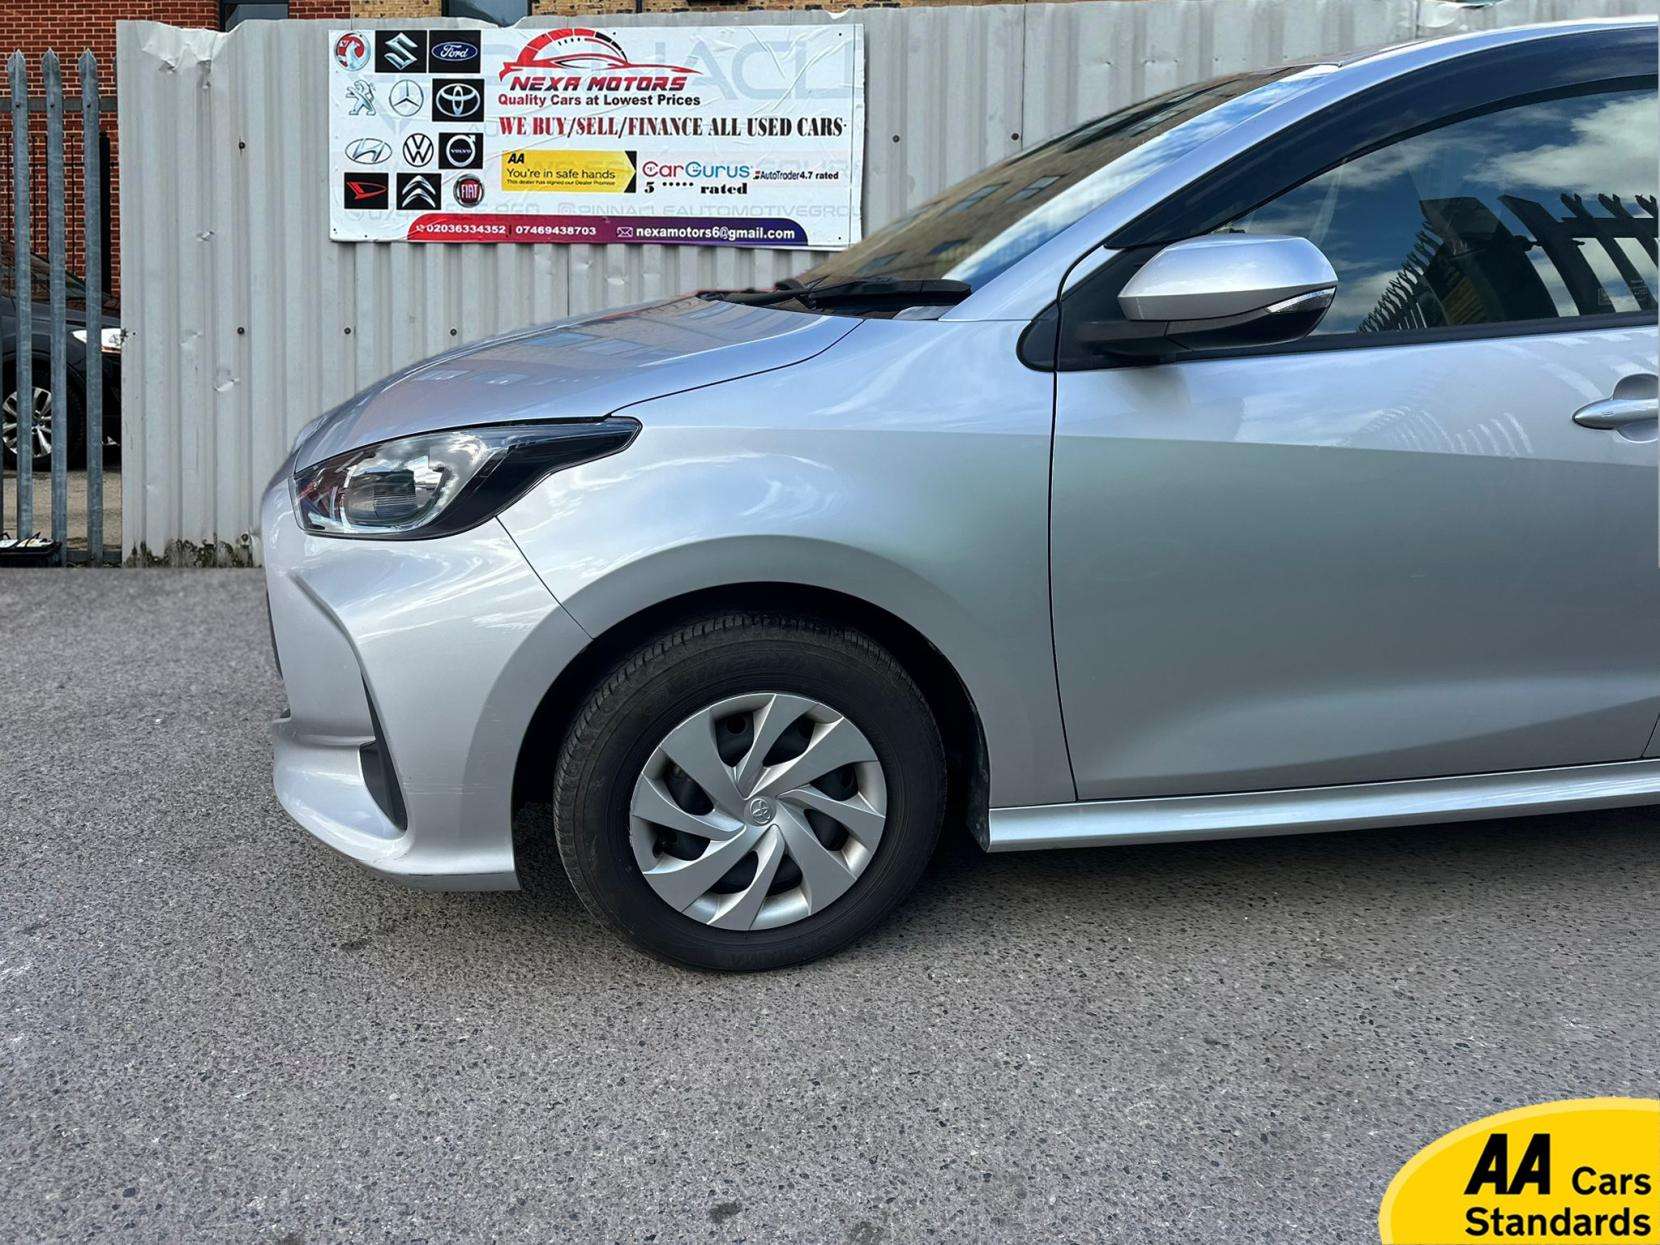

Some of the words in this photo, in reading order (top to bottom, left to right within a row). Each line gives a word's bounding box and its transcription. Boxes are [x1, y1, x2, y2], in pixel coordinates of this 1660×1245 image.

[440, 44, 468, 59] Ford
[510, 76, 582, 91] NEXA
[587, 76, 687, 91] MOTORS
[498, 93, 547, 108] Quality
[551, 94, 582, 106] Cars
[586, 94, 600, 106] at
[604, 94, 653, 106] Lowest
[657, 94, 701, 106] Prices
[499, 117, 527, 136] WE
[532, 117, 703, 139] BUY/SELL/FINANCE
[708, 117, 742, 137] ALL
[747, 117, 792, 137] USED
[797, 117, 843, 137] CARS
[507, 153, 525, 164] AA
[507, 168, 541, 179] You're
[543, 168, 553, 179] in
[556, 168, 579, 180] safe
[582, 169, 616, 180] hands
[642, 160, 751, 179] CarGurus
[800, 170, 814, 180] 4.7
[815, 170, 839, 180] rated
[460, 183, 479, 199] FIAT
[644, 182, 655, 195] 5
[700, 182, 748, 195] rated
[426, 224, 506, 234] 02036334352
[515, 226, 597, 236] 07469438703
[636, 226, 796, 240] nexamotors6@gmail.com
